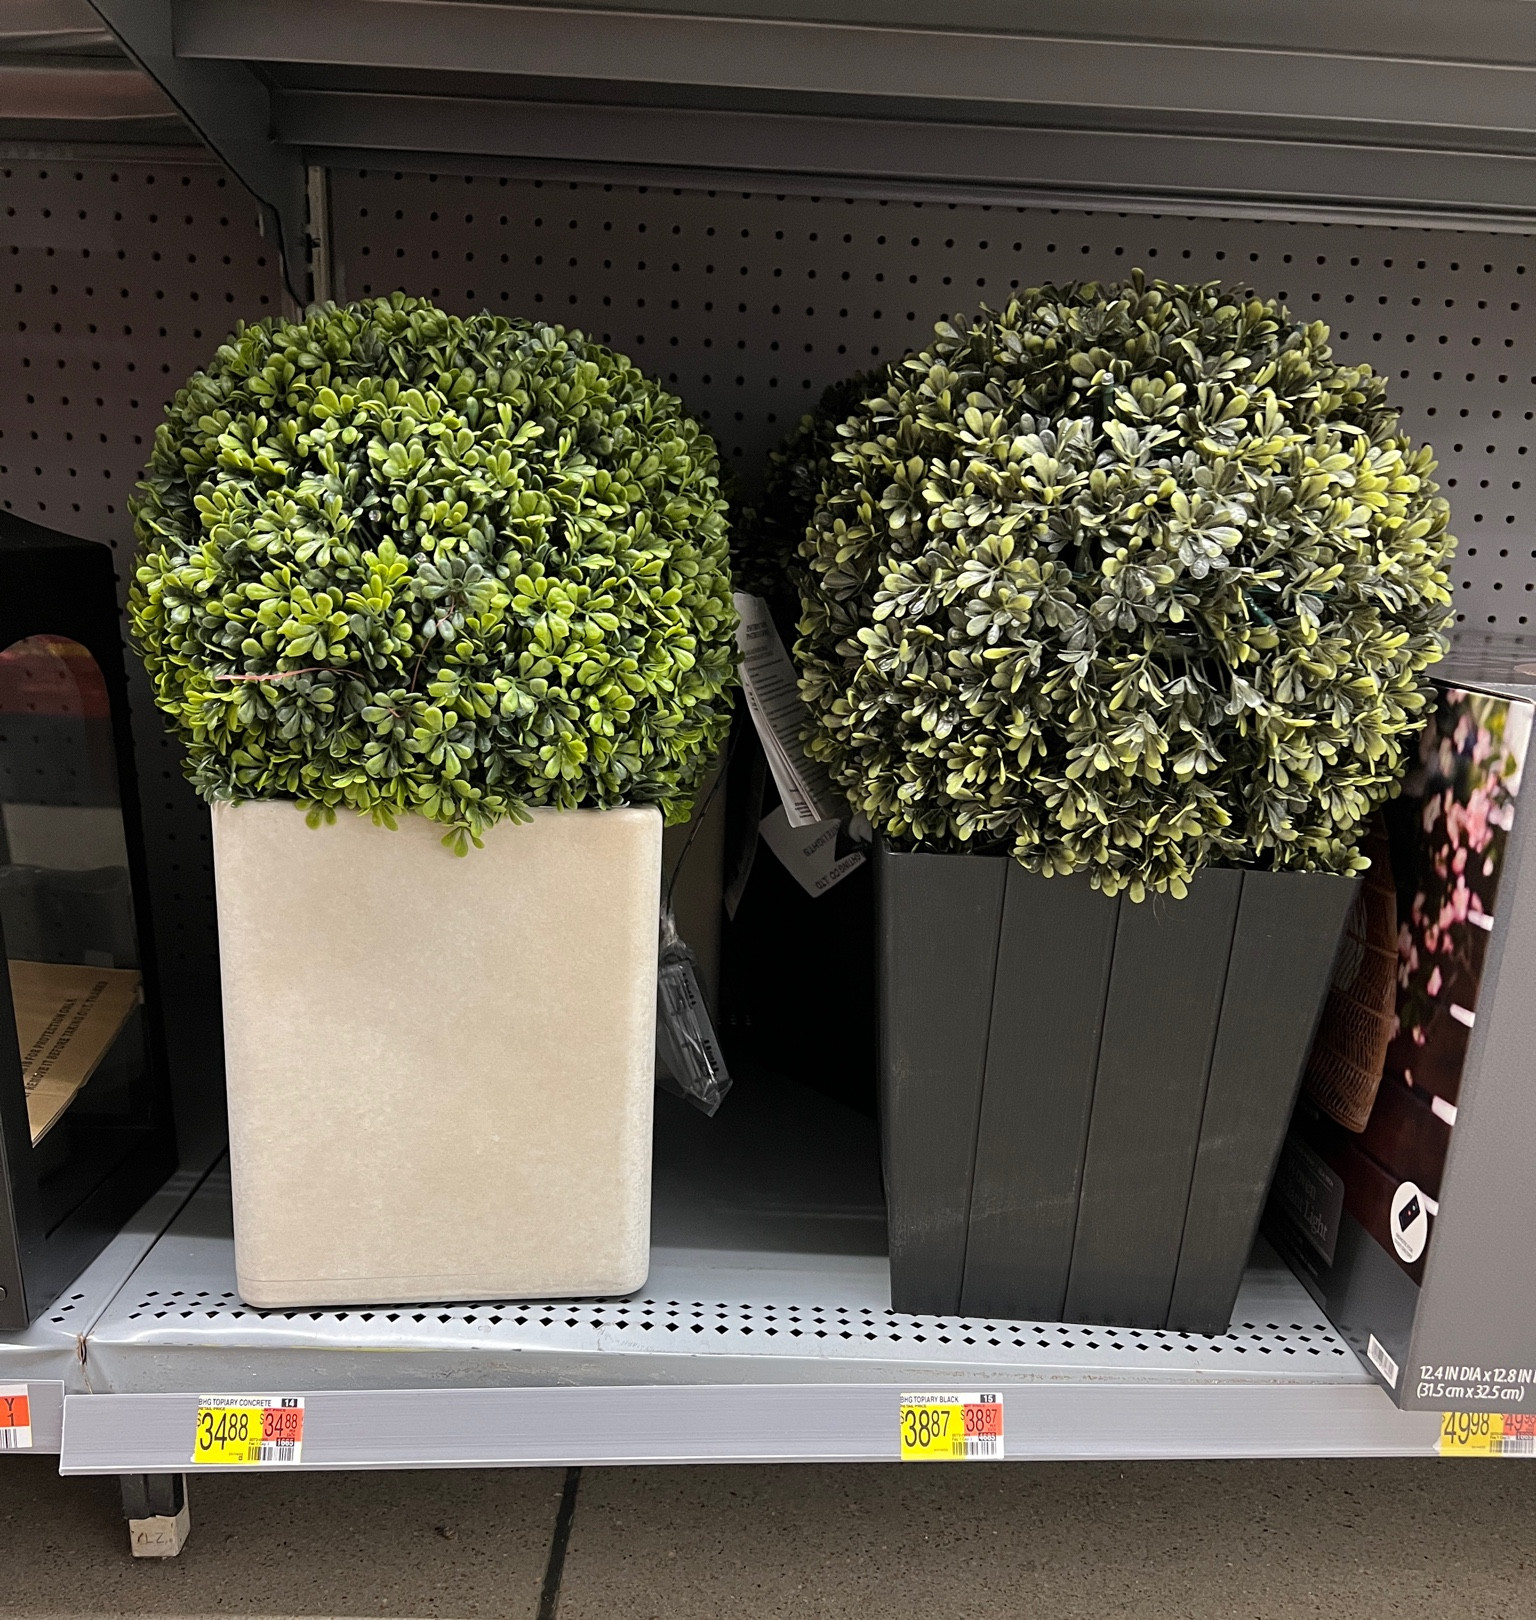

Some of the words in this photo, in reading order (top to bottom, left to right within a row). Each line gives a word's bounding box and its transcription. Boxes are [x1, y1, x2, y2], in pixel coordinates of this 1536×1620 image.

[836, 851, 863, 875] GHTING
[33, 1013, 68, 1050] PROTECTION
[46, 1037, 72, 1061] BEFORE
[1420, 1366, 1443, 1380] 12.4
[1444, 1366, 1459, 1380] IN
[1460, 1367, 1481, 1381] DIA
[1483, 1370, 1492, 1382] x
[1493, 1368, 1517, 1382] 12.8
[1518, 1369, 1531, 1384] IN
[983, 1394, 993, 1403] 15
[1417, 1382, 1445, 1399] (31.5
[1445, 1386, 1464, 1398] cm
[1465, 1387, 1474, 1398] x
[1474, 1385, 1501, 1399] 32.5
[1501, 1386, 1525, 1402] cm)
[238, 1399, 272, 1407] CONCRETE
[285, 1399, 294, 1407] 14
